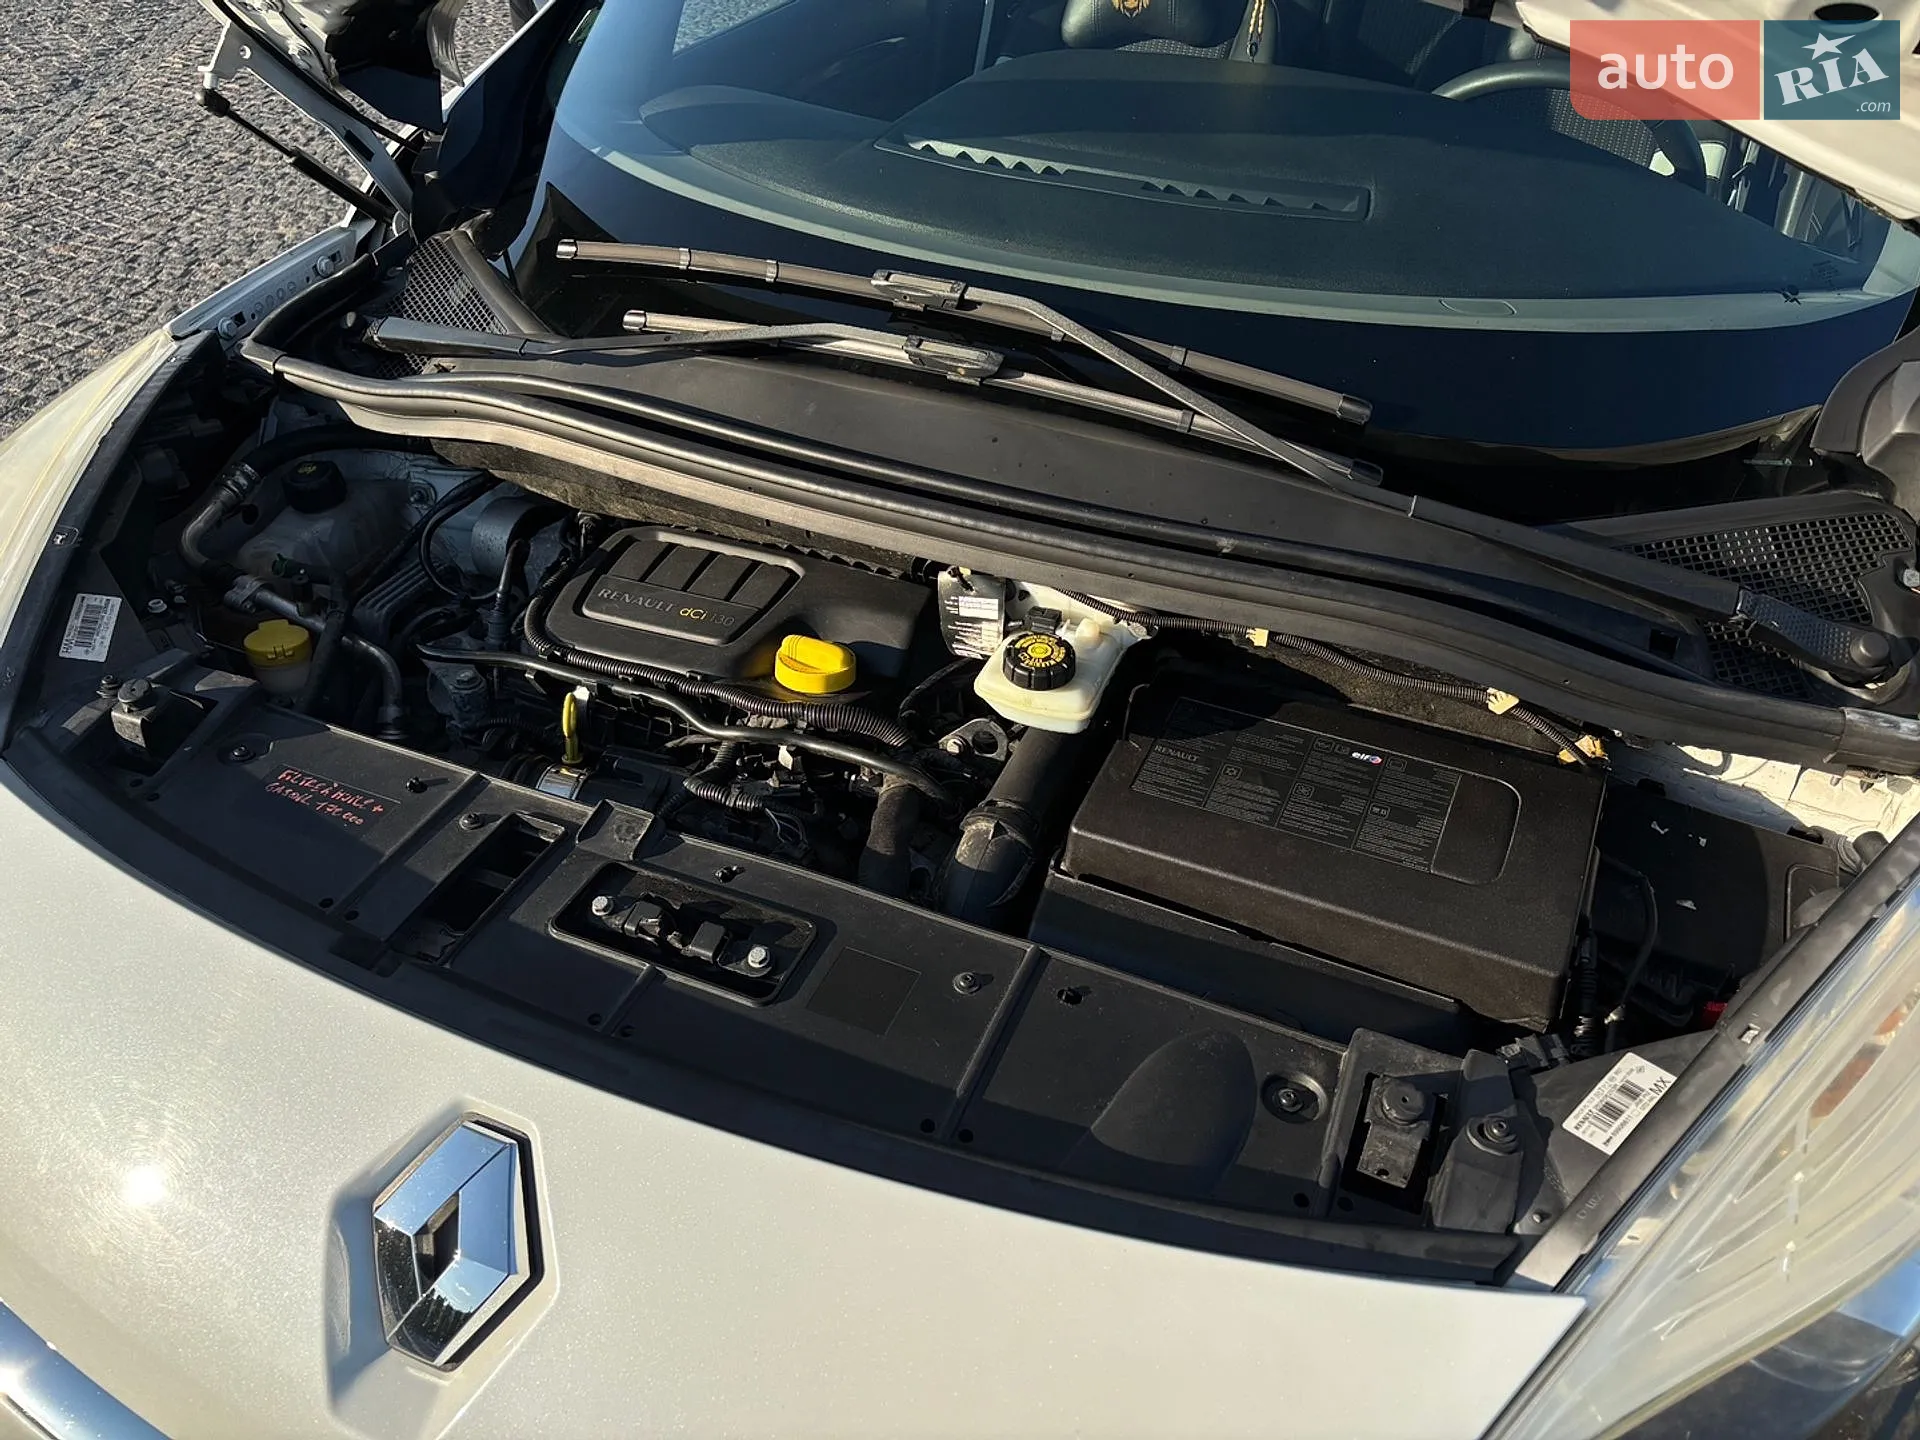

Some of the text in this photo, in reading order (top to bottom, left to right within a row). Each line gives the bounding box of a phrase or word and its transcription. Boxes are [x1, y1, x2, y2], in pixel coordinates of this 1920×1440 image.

[598, 588, 676, 612] RENAULT
[679, 606, 708, 621] dCi
[1154, 744, 1200, 763] RENAULT
[1351, 750, 1374, 762] elf
[1648, 1076, 1672, 1096] MX
